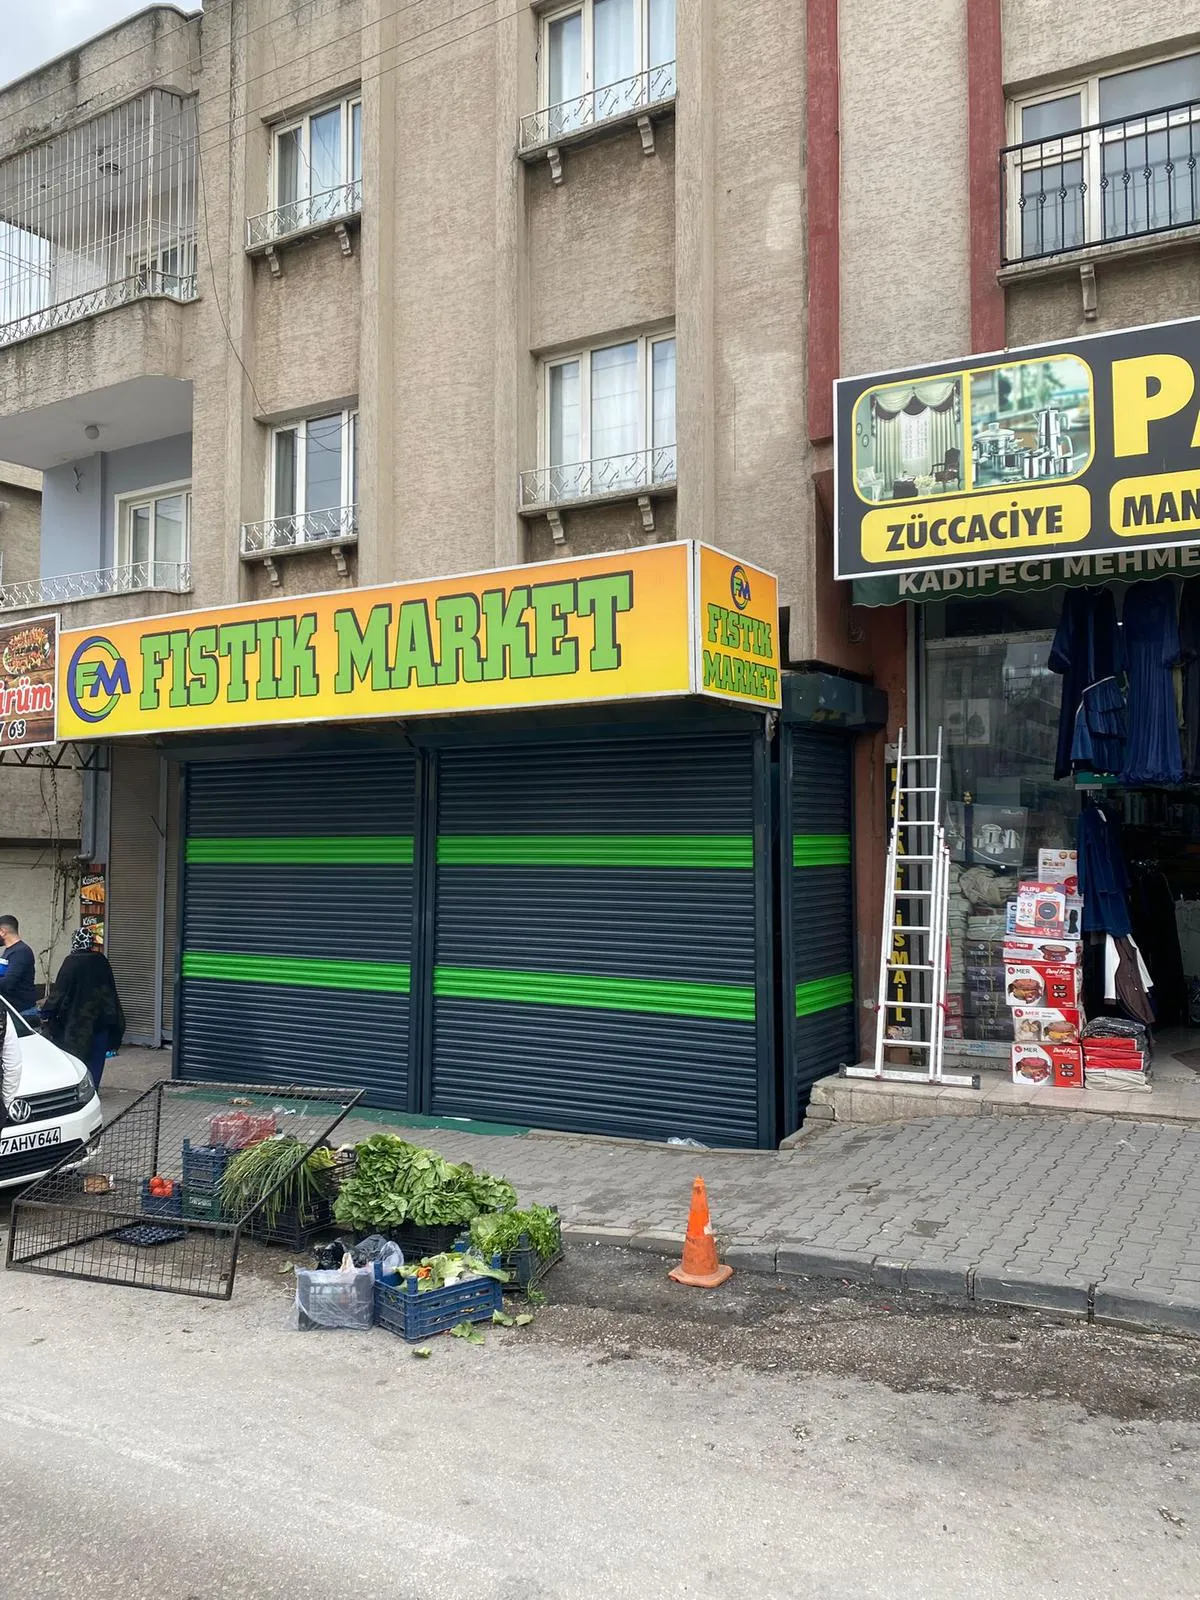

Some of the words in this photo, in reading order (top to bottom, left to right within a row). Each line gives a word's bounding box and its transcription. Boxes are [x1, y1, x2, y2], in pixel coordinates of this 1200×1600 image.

[1112, 354, 1200, 458] P
[886, 501, 1063, 552] ZÜCCACİYE
[140, 611, 318, 711] FISTIK
[334, 570, 633, 694] MARKET
[707, 603, 773, 659] FISTIK
[0, 677, 53, 717] rüm
[75, 656, 131, 699] FM
[703, 650, 777, 700] MARKET
[9, 719, 26, 739] 63
[38, 1129, 59, 1146] 644
